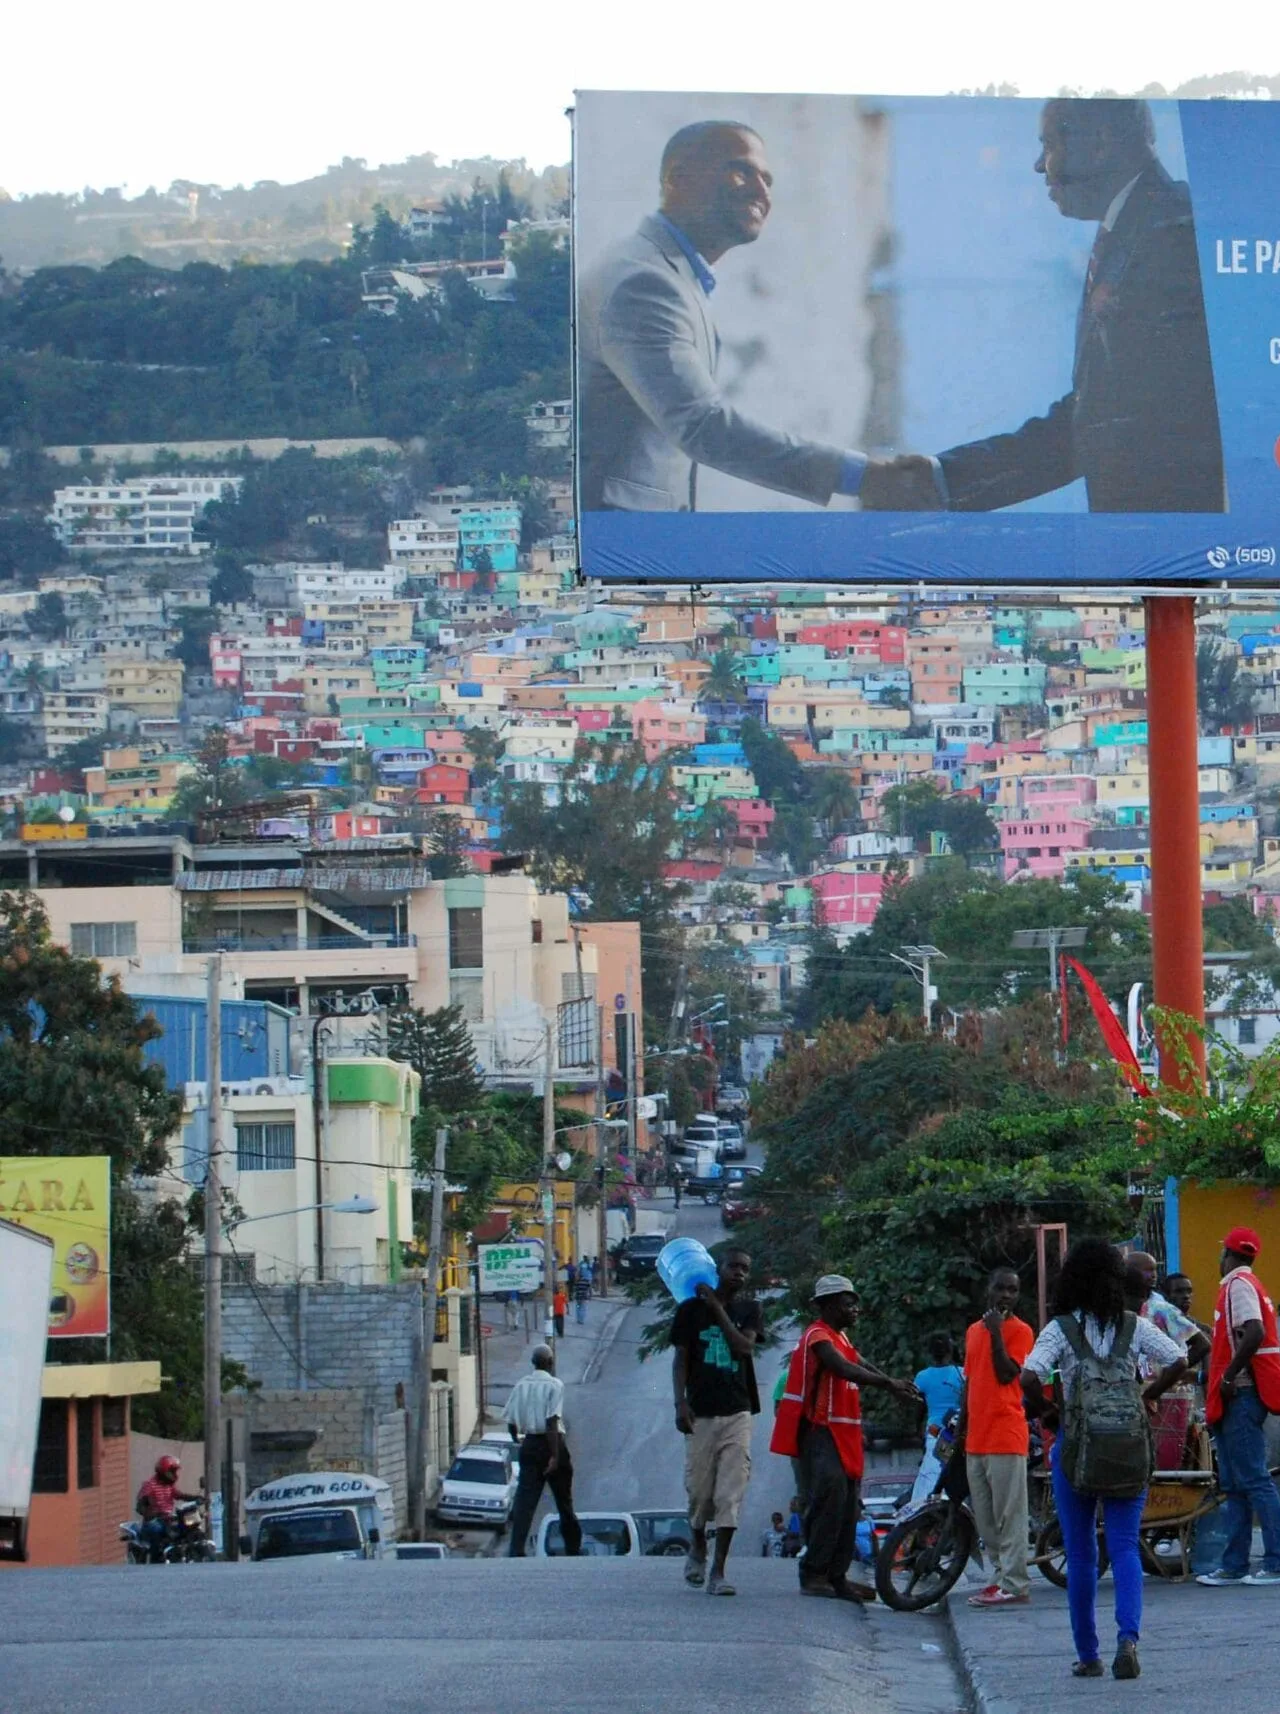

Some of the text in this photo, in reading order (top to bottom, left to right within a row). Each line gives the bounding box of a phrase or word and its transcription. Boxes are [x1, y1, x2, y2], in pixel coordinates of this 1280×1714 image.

[1216, 240, 1248, 274] LE
[1235, 547, 1275, 566] (509)
[0, 1178, 95, 1212] ARA
